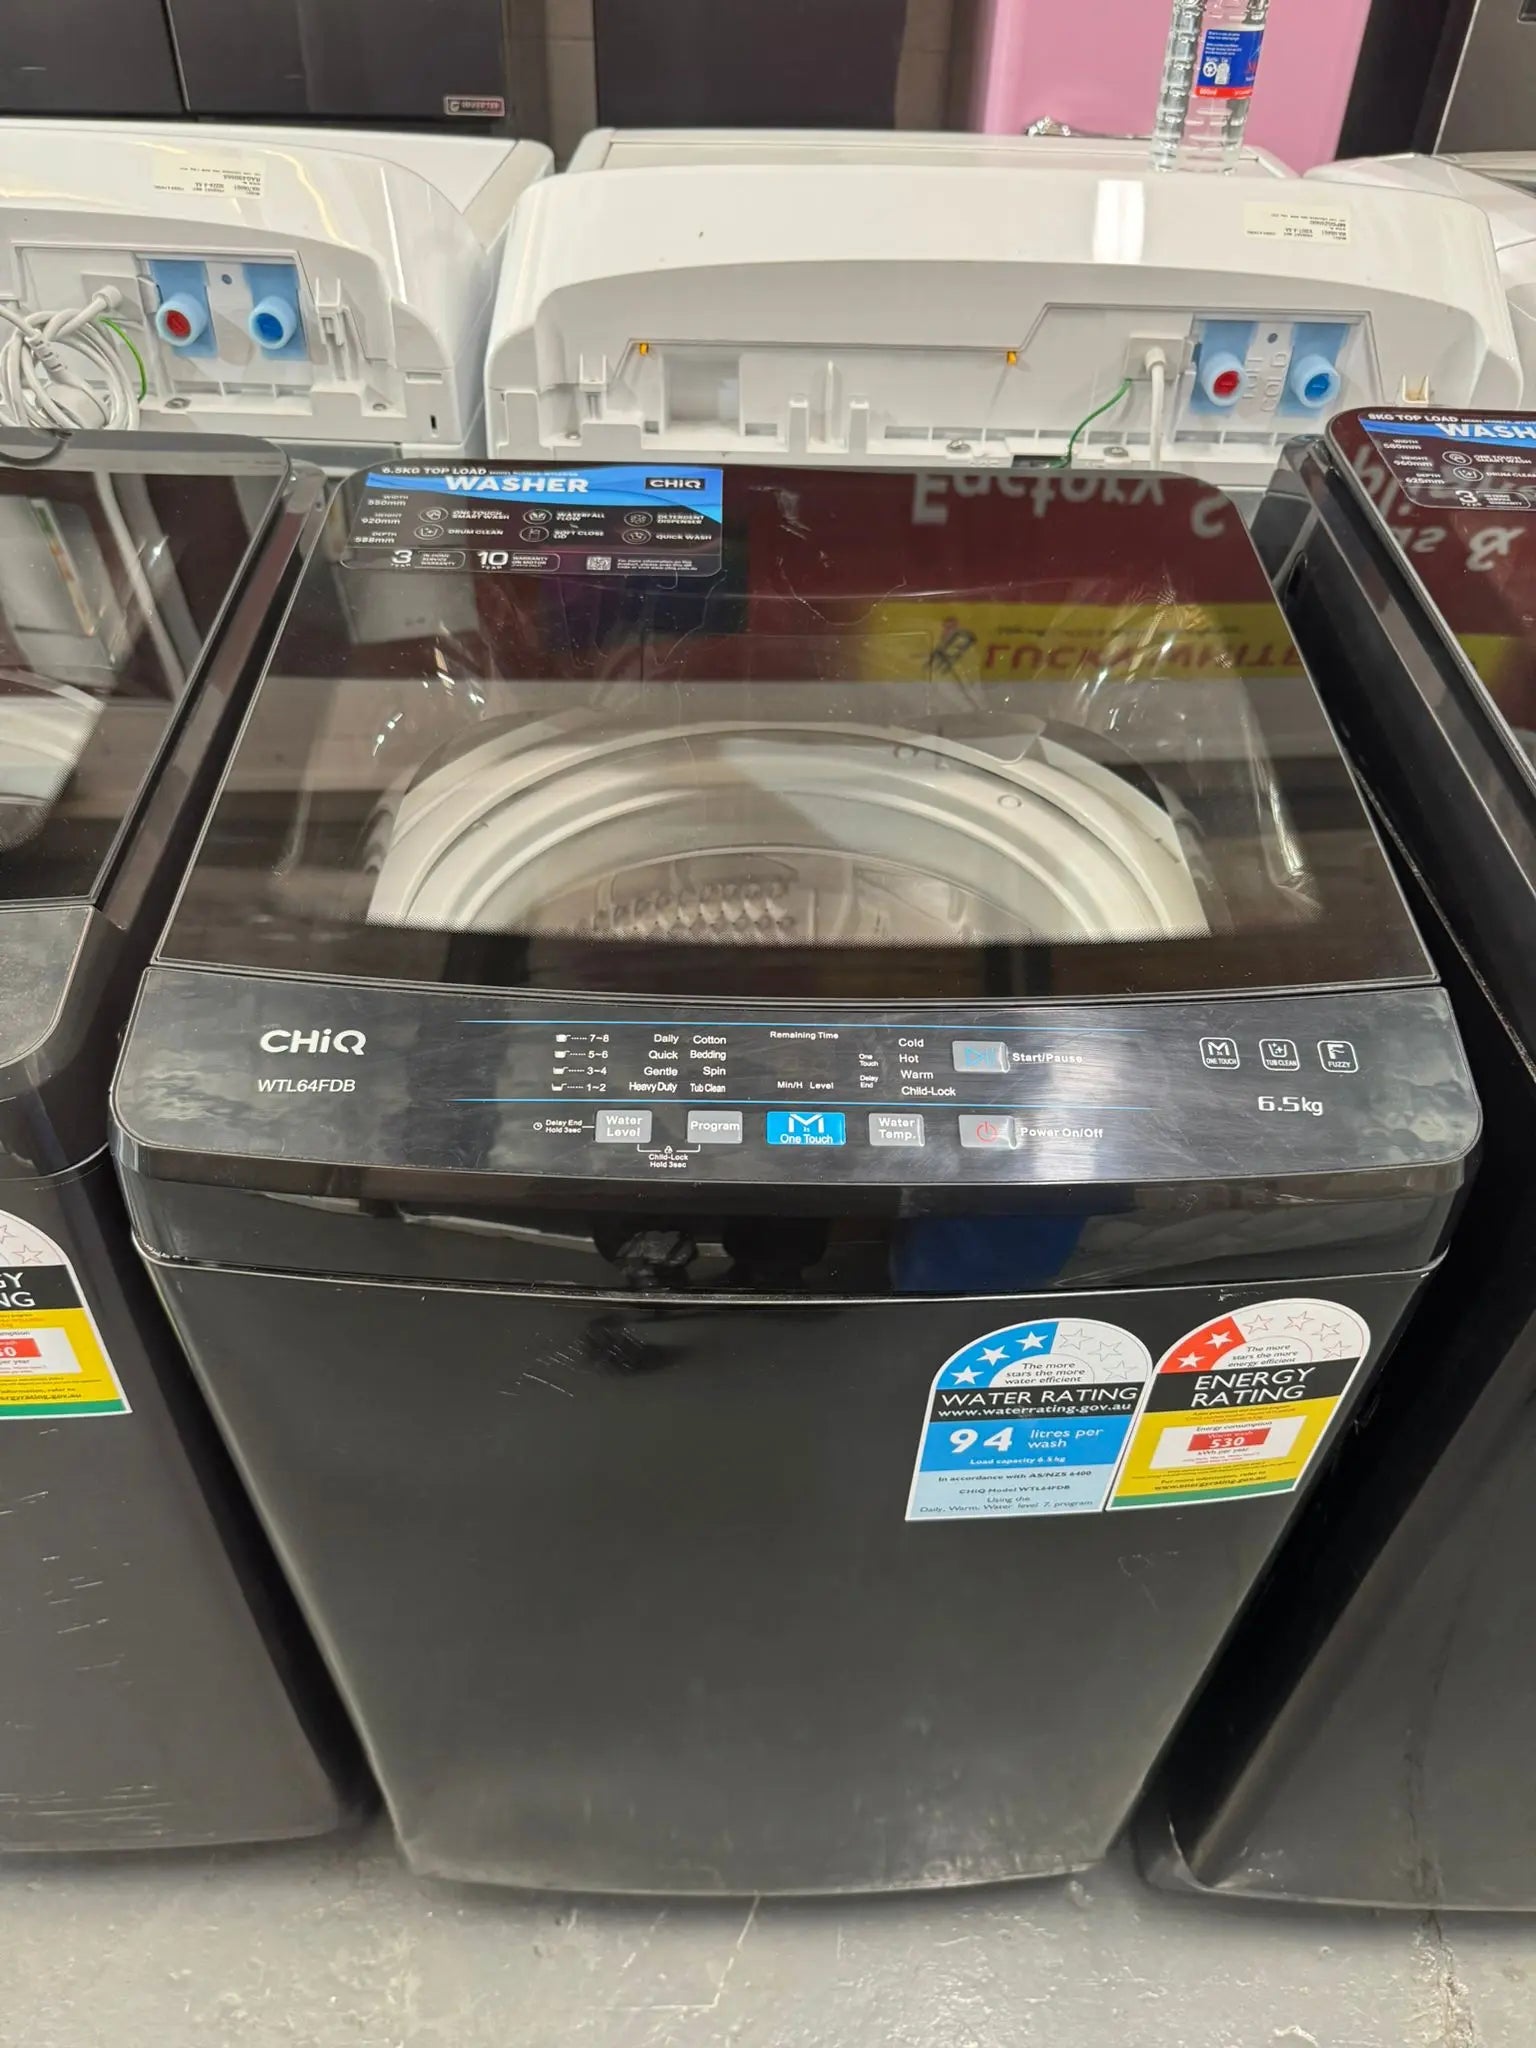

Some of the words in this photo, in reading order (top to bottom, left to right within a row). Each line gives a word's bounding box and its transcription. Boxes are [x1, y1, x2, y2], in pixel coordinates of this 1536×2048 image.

[1368, 413, 1393, 421] 8KG
[1435, 423, 1536, 439] WASH
[382, 466, 420, 475] 6.5KG
[424, 467, 450, 475] TOP
[452, 467, 487, 475] LOAD
[445, 475, 589, 493] WASHER
[1455, 490, 1478, 503] 3
[391, 549, 413, 564] 3
[477, 551, 509, 566] 10
[653, 1034, 680, 1044] Daily
[692, 1035, 727, 1045] Cotton
[770, 1031, 816, 1041] Remaining
[817, 1031, 839, 1040] Time
[898, 1038, 925, 1048] Cold
[648, 1050, 679, 1060] Quick
[690, 1050, 727, 1061] Bedding
[899, 1054, 920, 1064] Hot
[1012, 1052, 1083, 1064] Start/Pause
[643, 1066, 679, 1076] Gentle
[702, 1066, 727, 1078] Spin
[900, 1069, 934, 1080] Warm
[860, 1075, 879, 1083] Delay
[258, 1079, 356, 1093] WTL64FDB
[628, 1081, 657, 1093] Heavy
[657, 1082, 678, 1093] Duty
[690, 1083, 704, 1093] Tub
[704, 1083, 726, 1093] Clean
[777, 1081, 804, 1089] Min/H
[809, 1081, 835, 1090] Level
[901, 1086, 957, 1097] Child-Lock
[1257, 1096, 1324, 1116] 6.5kg
[545, 1119, 567, 1127] Delay
[606, 1115, 643, 1125] Water
[878, 1118, 916, 1127] Water
[545, 1126, 563, 1134] Hold
[690, 1120, 740, 1132] Program
[606, 1127, 641, 1137] Level
[879, 1129, 917, 1141] Temp.
[1020, 1127, 1060, 1137] Power
[1062, 1128, 1104, 1138] On/Off
[780, 1133, 802, 1144] One
[804, 1133, 833, 1145] Touch
[648, 1153, 689, 1161] Child-Lock
[1022, 1362, 1043, 1370] The
[1260, 1357, 1297, 1365] efficient
[1035, 1369, 1054, 1377] the
[1194, 1366, 1317, 1391] ENERGY
[941, 1390, 1032, 1407] WATER
[1041, 1387, 1139, 1403] RATING
[1191, 1384, 1306, 1408] RATING
[938, 1402, 1132, 1418] www.waterrating.gov.au
[1223, 1422, 1273, 1430] consumption
[1030, 1428, 1070, 1439] litres
[1075, 1428, 1104, 1440] per
[950, 1426, 1014, 1454] 94
[1028, 1439, 1067, 1449] wash
[1209, 1436, 1245, 1449] 530
[996, 1457, 1036, 1465] capacity
[1053, 1501, 1093, 1509] program
